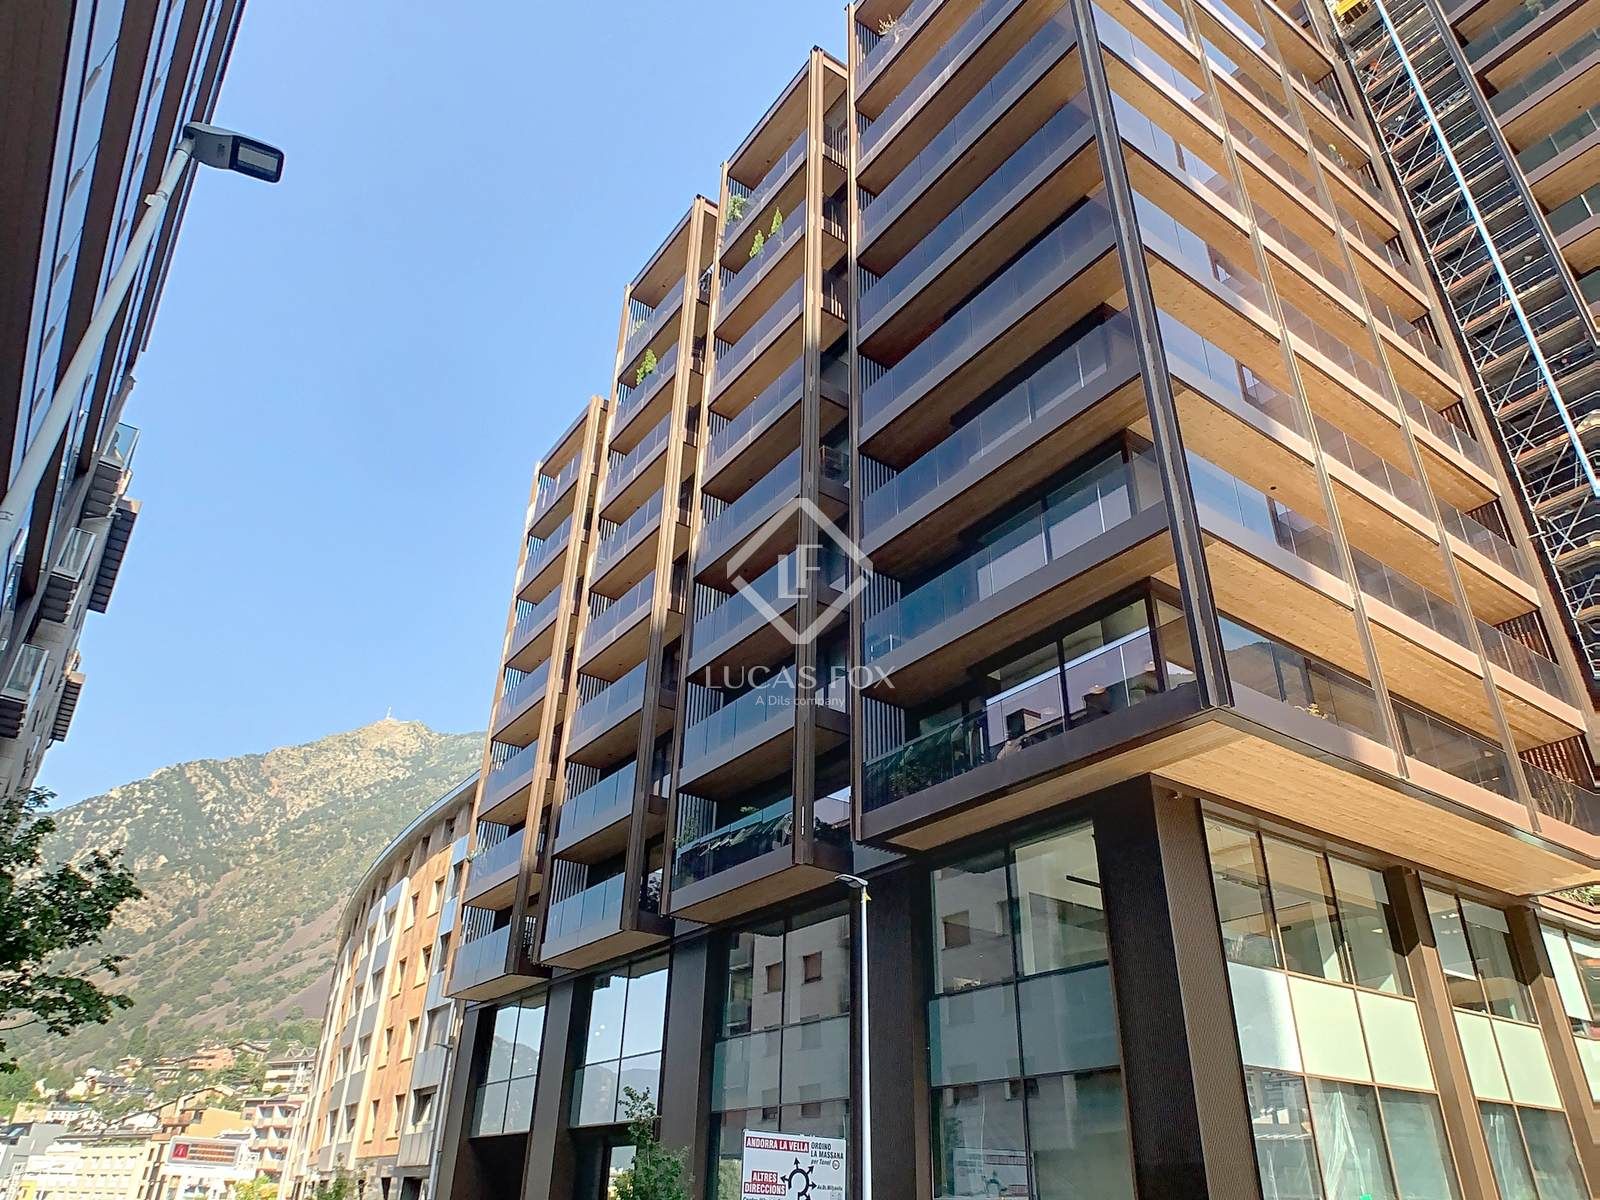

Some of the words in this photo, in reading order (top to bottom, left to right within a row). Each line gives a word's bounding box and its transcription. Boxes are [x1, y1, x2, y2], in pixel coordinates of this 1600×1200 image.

[746, 1137, 778, 1149] ANDORRA
[779, 1140, 788, 1150] LA
[789, 1141, 809, 1152] VELLA
[810, 1141, 832, 1151] ORDINO
[818, 1151, 844, 1159] MASSANA
[752, 1171, 777, 1183] ALTRES
[744, 1182, 786, 1195] DIRECCIONS
